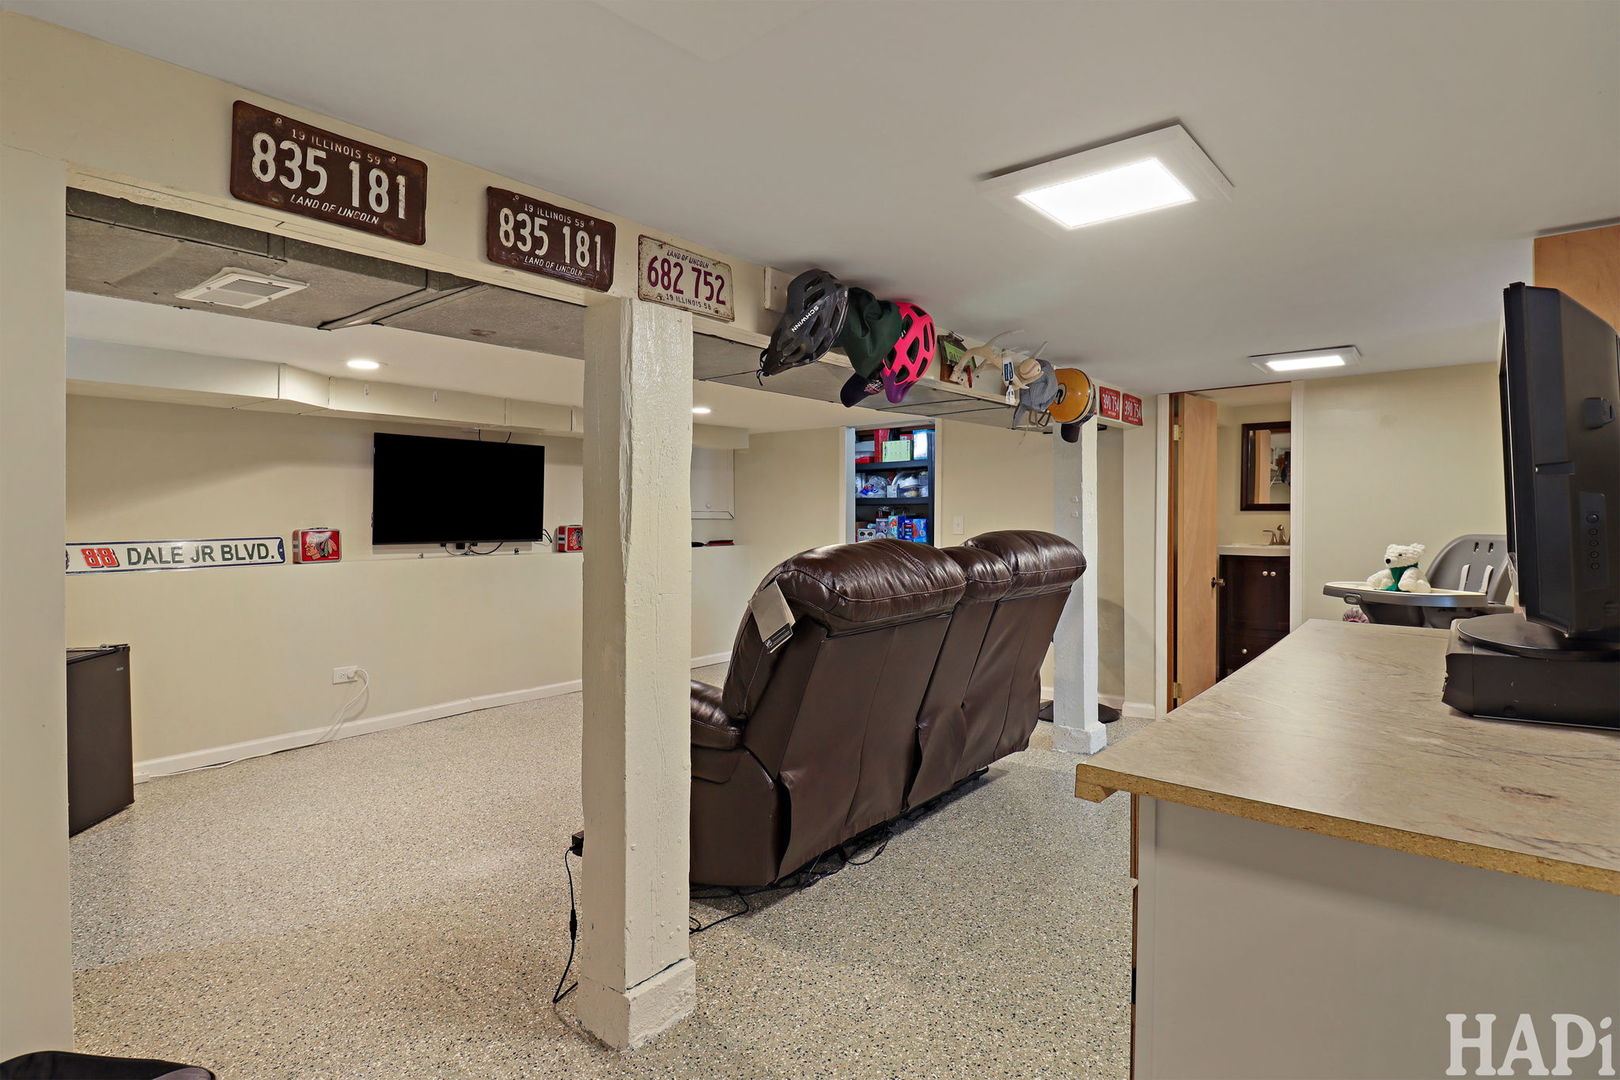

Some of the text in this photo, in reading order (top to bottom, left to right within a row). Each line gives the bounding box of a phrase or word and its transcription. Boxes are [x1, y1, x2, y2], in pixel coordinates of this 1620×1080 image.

[292, 128, 381, 165] 19 ILLINOIS 59
[251, 131, 406, 220] 835 181
[289, 194, 380, 225] LAND OF LINCOLN
[524, 203, 534, 213] 19
[537, 207, 572, 224] ILLINOIS
[499, 207, 601, 272] 835 181
[524, 255, 584, 276] LAND OF LINCOLN
[667, 250, 681, 260] LAND
[689, 257, 709, 268] LINCOLN
[647, 255, 726, 306] 682 752
[676, 296, 701, 307] ILLINOIS
[791, 304, 819, 333] SCHWINN
[80, 543, 275, 569] 88 DALE JR BLVD.
